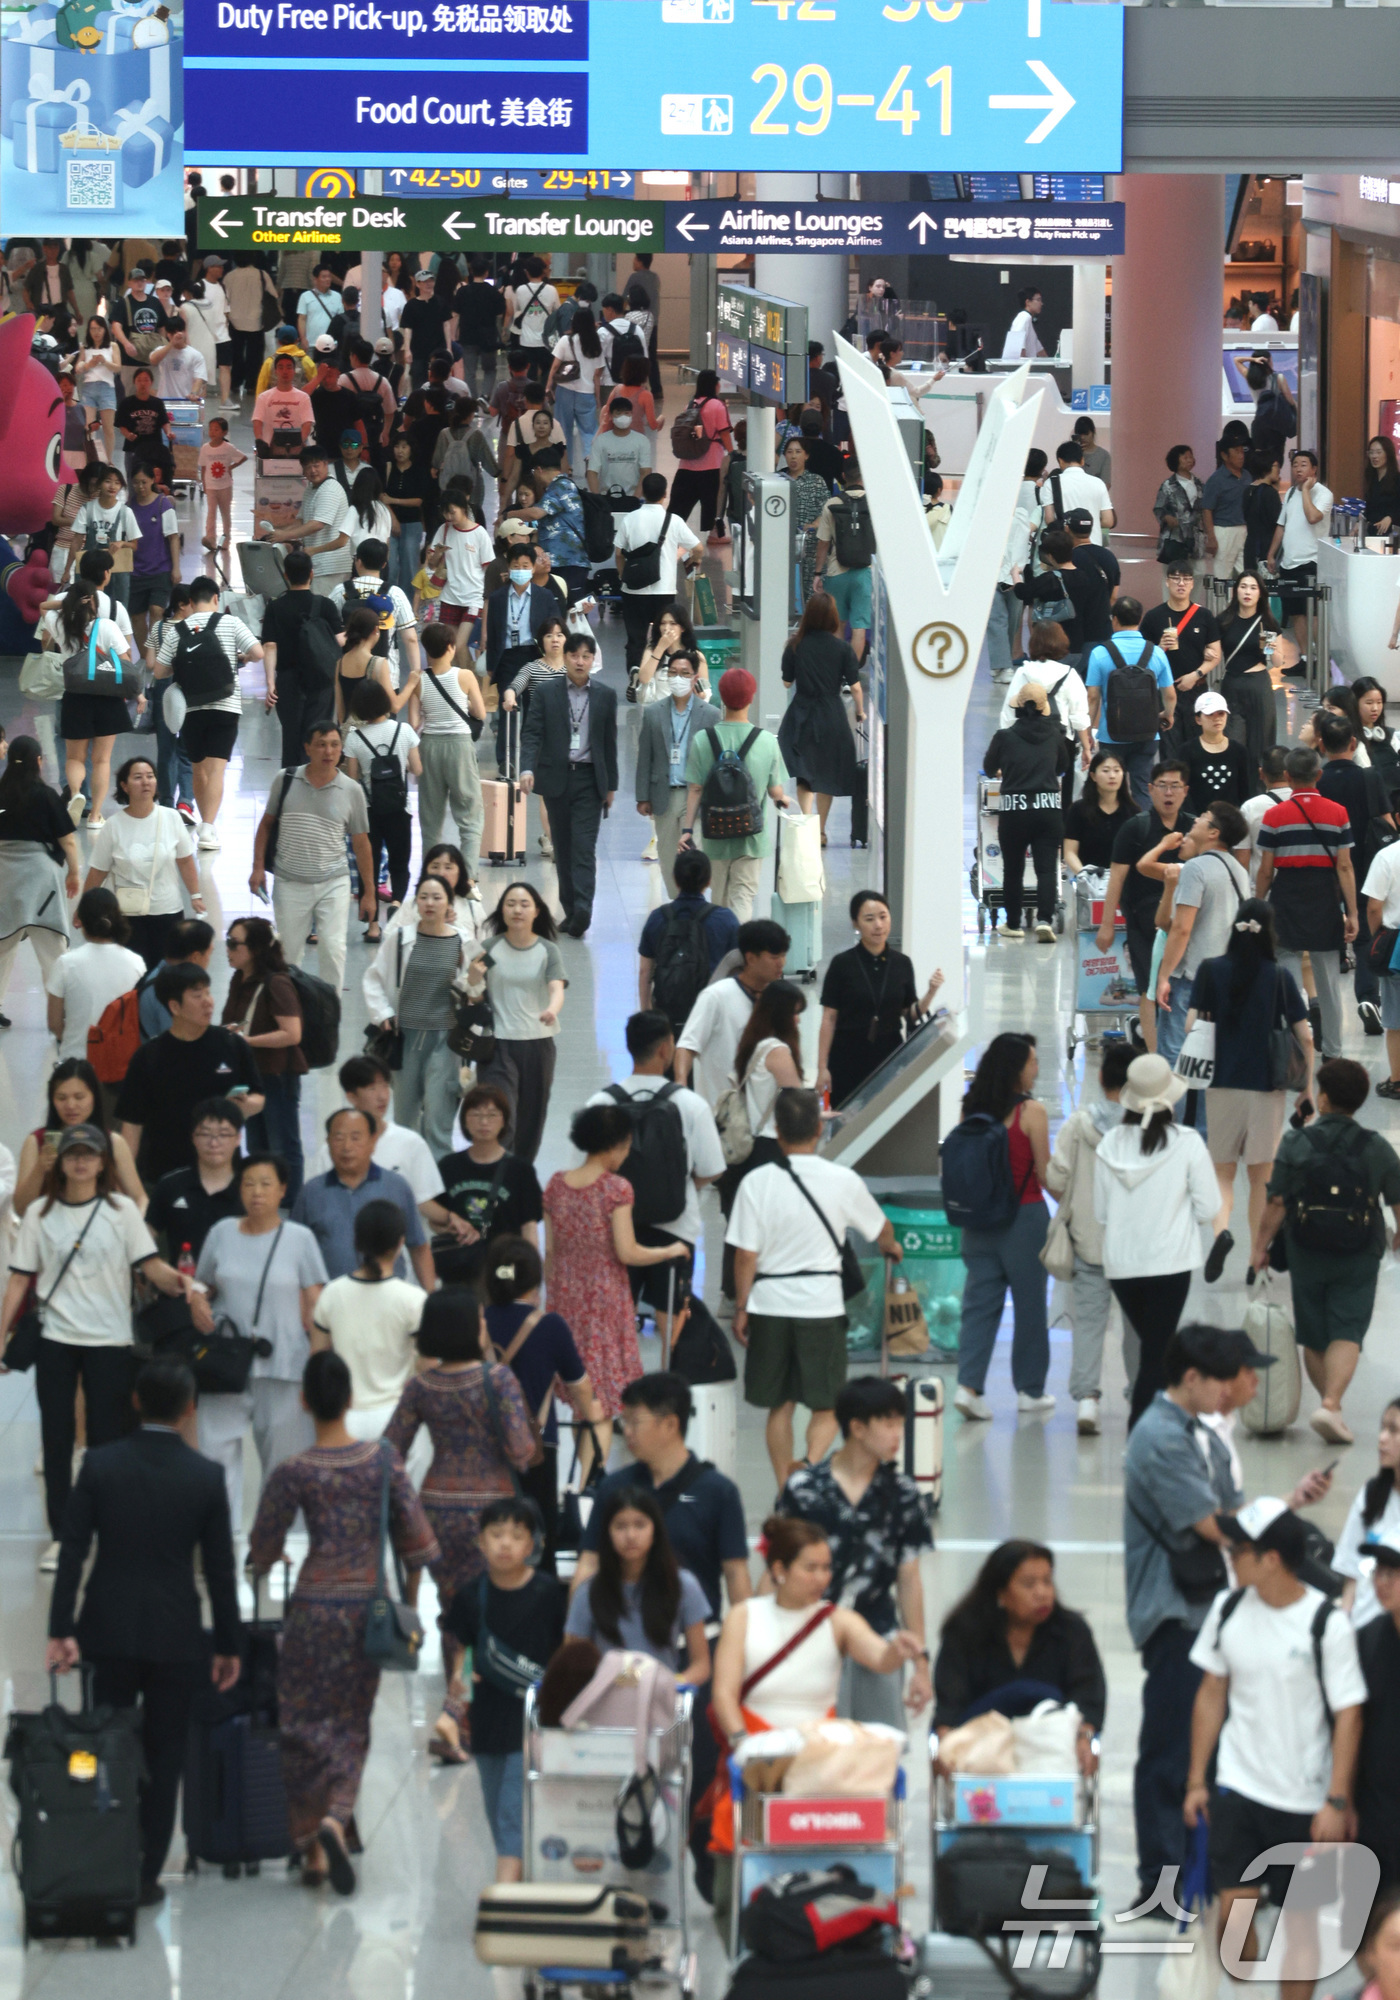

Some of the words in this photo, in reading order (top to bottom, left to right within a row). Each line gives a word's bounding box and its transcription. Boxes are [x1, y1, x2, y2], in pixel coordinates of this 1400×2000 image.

[218, 3, 273, 36] Duty
[278, 3, 328, 29] Free
[333, 2, 428, 37] Pick-up,
[432, 3, 573, 34] 免税品领取处
[356, 96, 417, 125] Food
[423, 96, 496, 127] Court,
[500, 97, 573, 127] 美食街
[409, 169, 481, 188] 42-50
[491, 176, 528, 189] Gates
[252, 206, 347, 228] Transfer
[352, 207, 407, 228] Desk
[484, 212, 570, 236] Transfer
[574, 214, 653, 242] Lounge
[719, 209, 791, 231] Airline
[795, 211, 883, 236] Lounges
[252, 231, 290, 243] Other
[292, 231, 341, 244] Airlines
[720, 235, 753, 245] Asiana
[754, 235, 793, 247] Airlines,
[795, 236, 845, 248] Singapore
[846, 236, 883, 246] Airlines
[1033, 231, 1053, 240] Duty
[1054, 231, 1071, 239] Free
[1072, 231, 1088, 239] Pick
